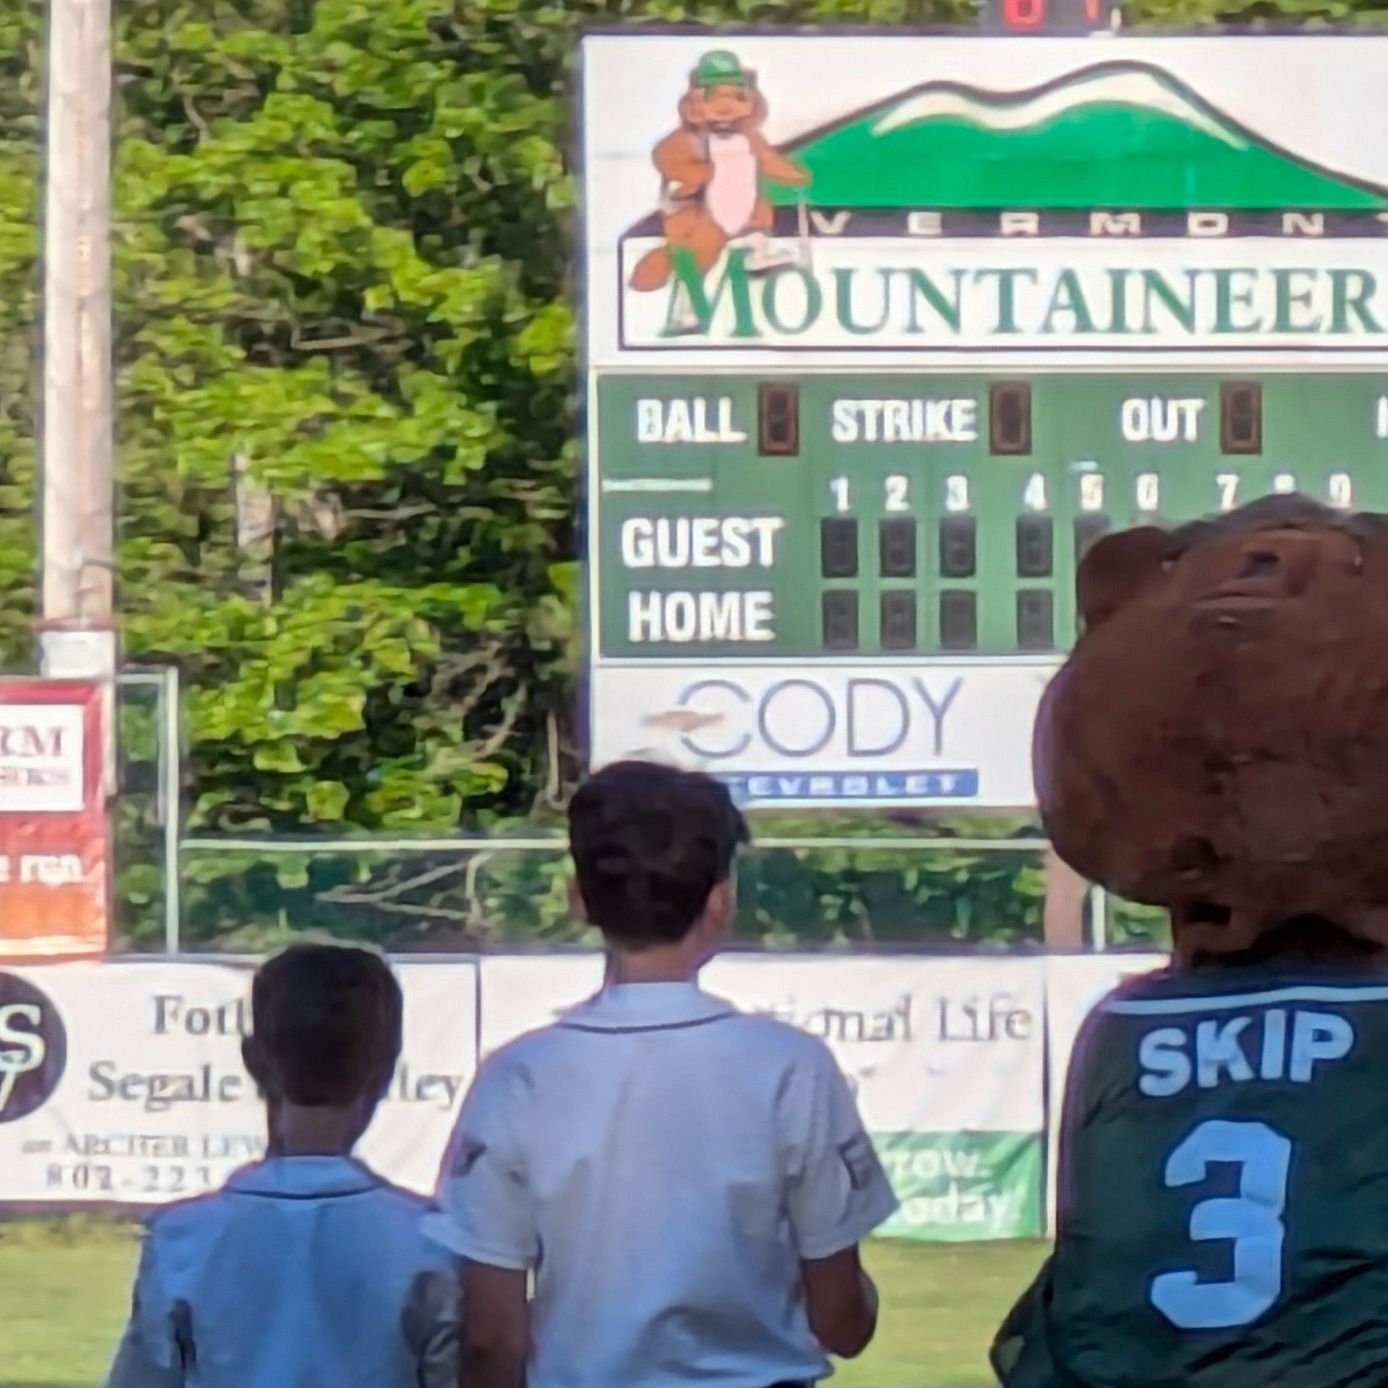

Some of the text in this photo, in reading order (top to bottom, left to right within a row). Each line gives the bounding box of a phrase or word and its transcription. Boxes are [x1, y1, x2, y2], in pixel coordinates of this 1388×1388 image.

[636, 396, 749, 443] BALL
[831, 398, 979, 443] STRIKE
[1120, 396, 1206, 442] OUT
[829, 474, 851, 512] 1
[883, 474, 911, 512] 2
[1023, 471, 1048, 512] 4
[1215, 473, 1240, 511] 7
[620, 514, 787, 568] GUEST
[627, 589, 777, 642] HOME
[676, 677, 964, 759] CODY
[730, 773, 958, 797] EVROLET
[936, 994, 1033, 1042] Life
[1138, 1008, 1355, 1097] SKIP
[87, 1060, 243, 1112] Segale
[1150, 1119, 1293, 1329] 3
